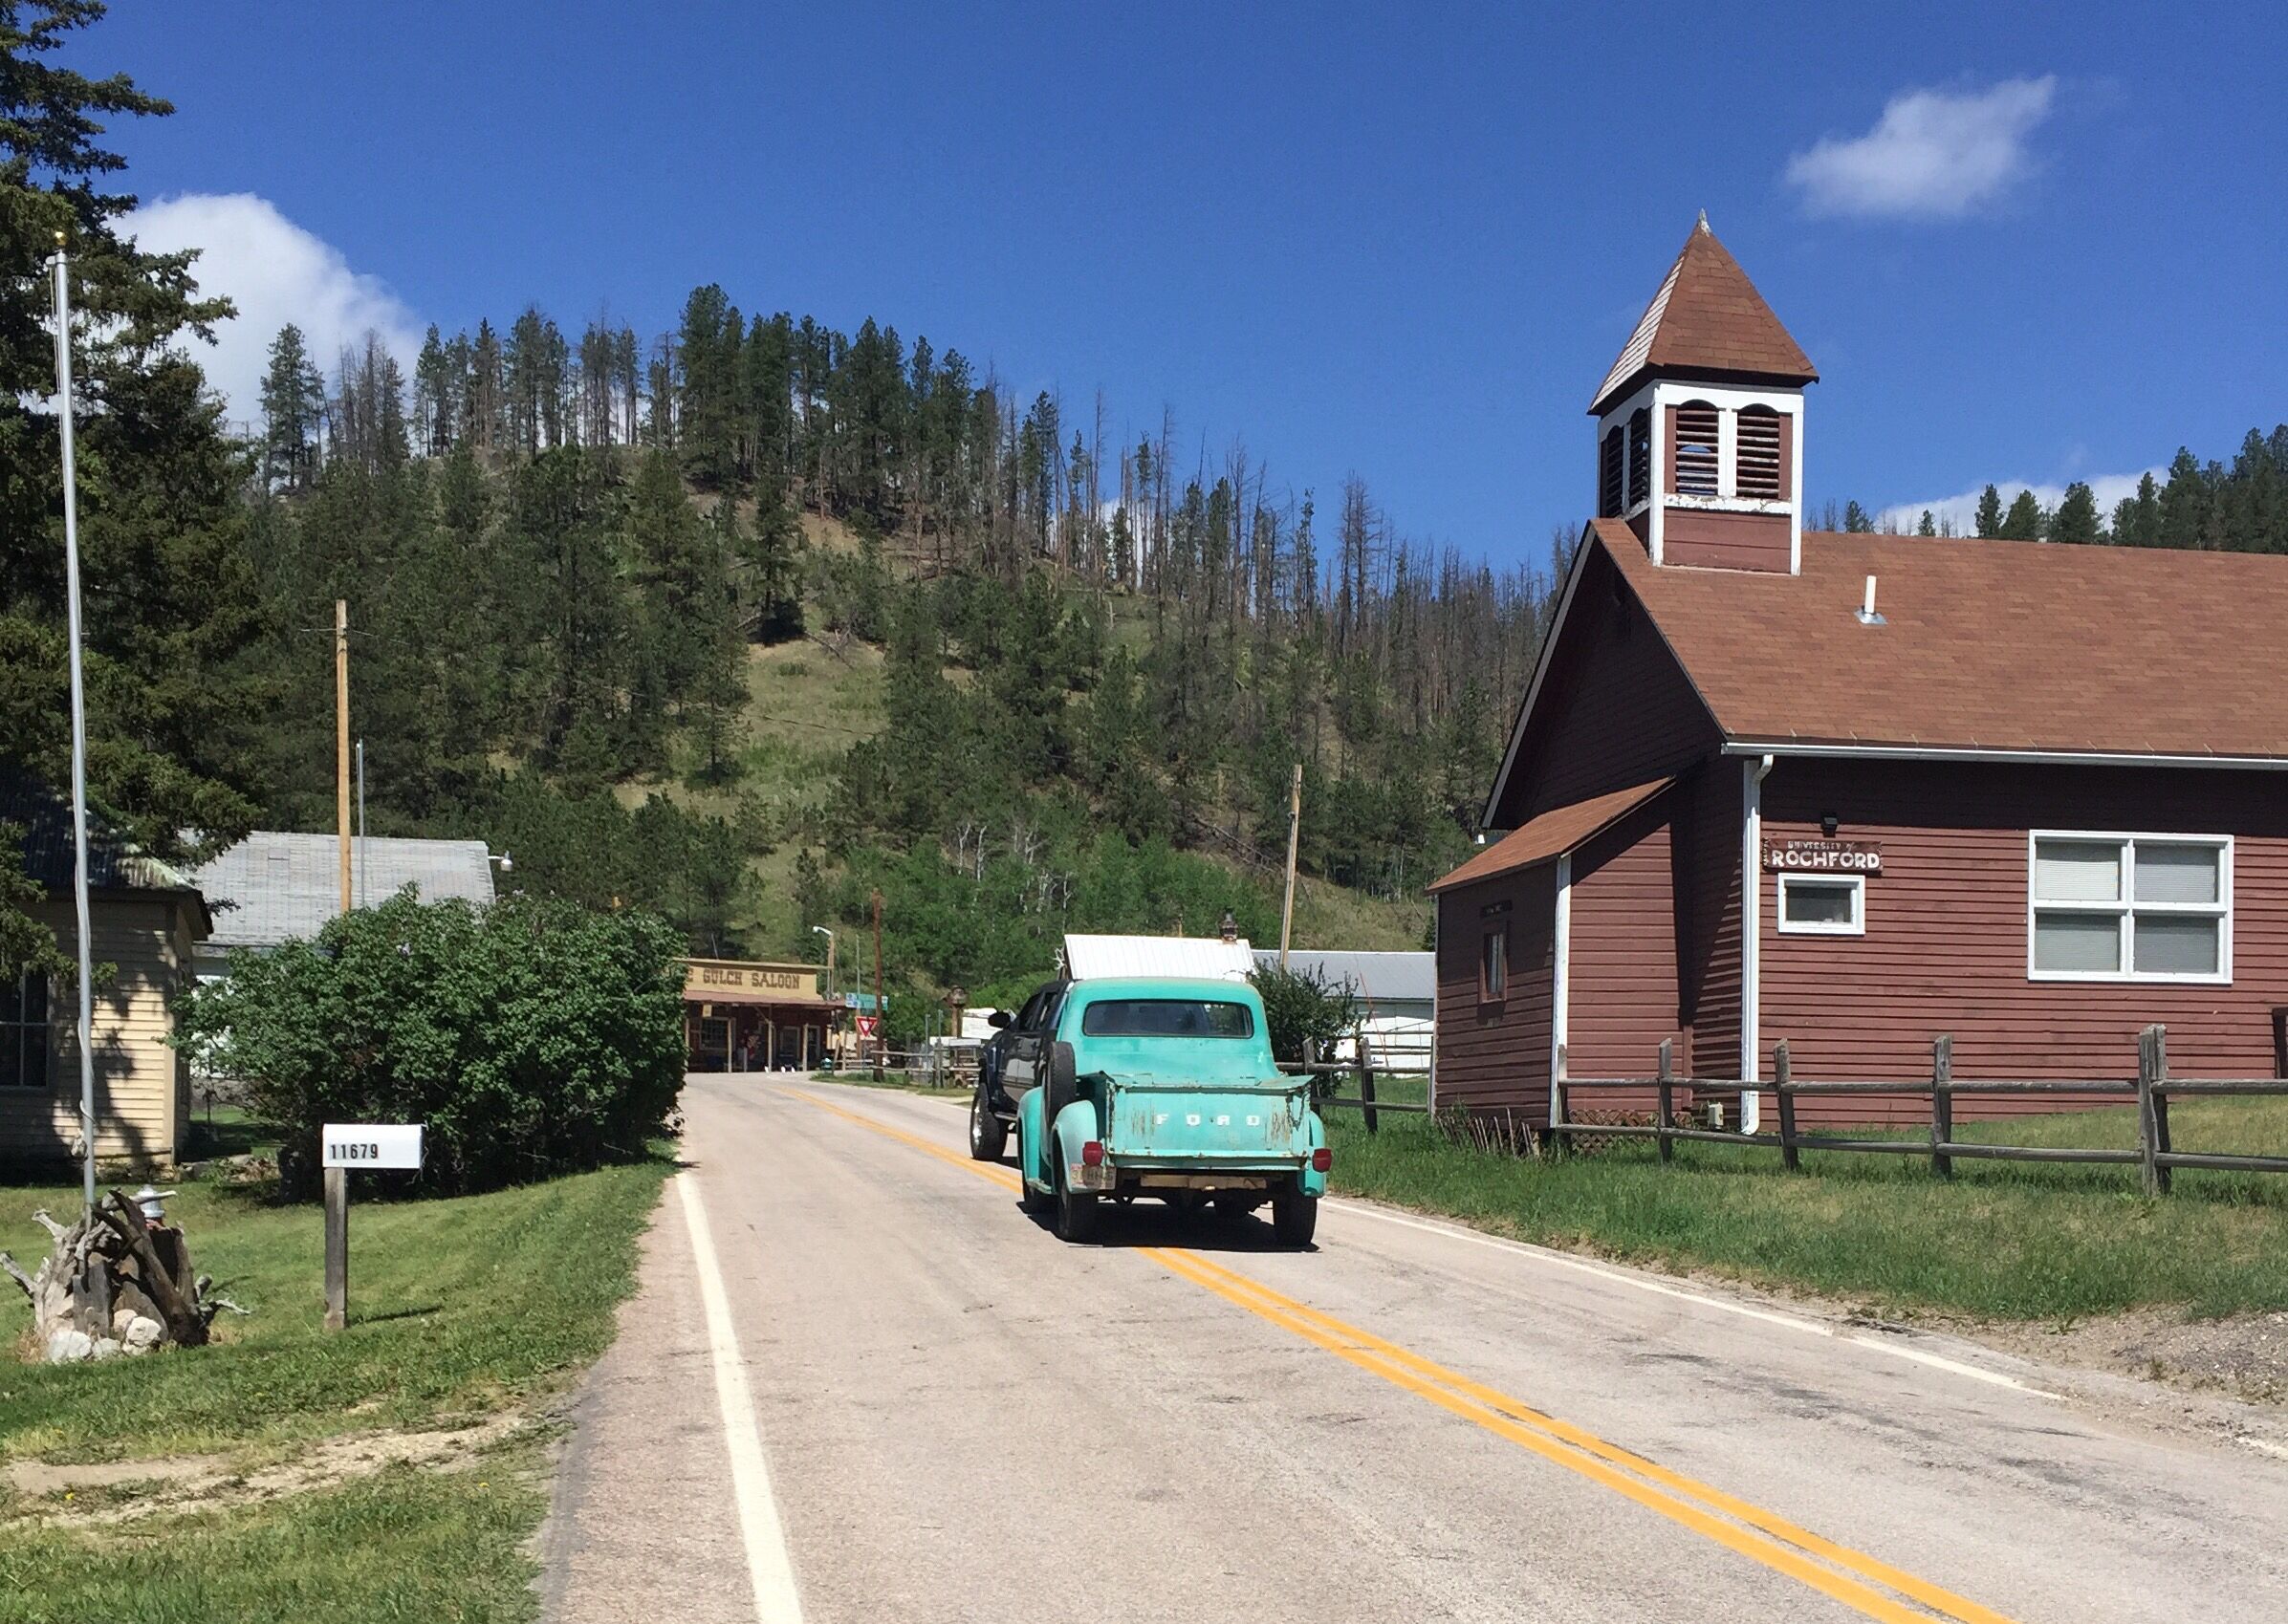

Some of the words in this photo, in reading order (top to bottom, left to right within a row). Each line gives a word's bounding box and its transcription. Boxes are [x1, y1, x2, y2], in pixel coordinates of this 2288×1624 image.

[1772, 850, 1880, 869] ROCHFORD
[703, 968, 743, 986] GULCH
[751, 972, 800, 989] SALOON
[1156, 1114, 1260, 1126] FORD
[330, 1143, 379, 1159] 11679
